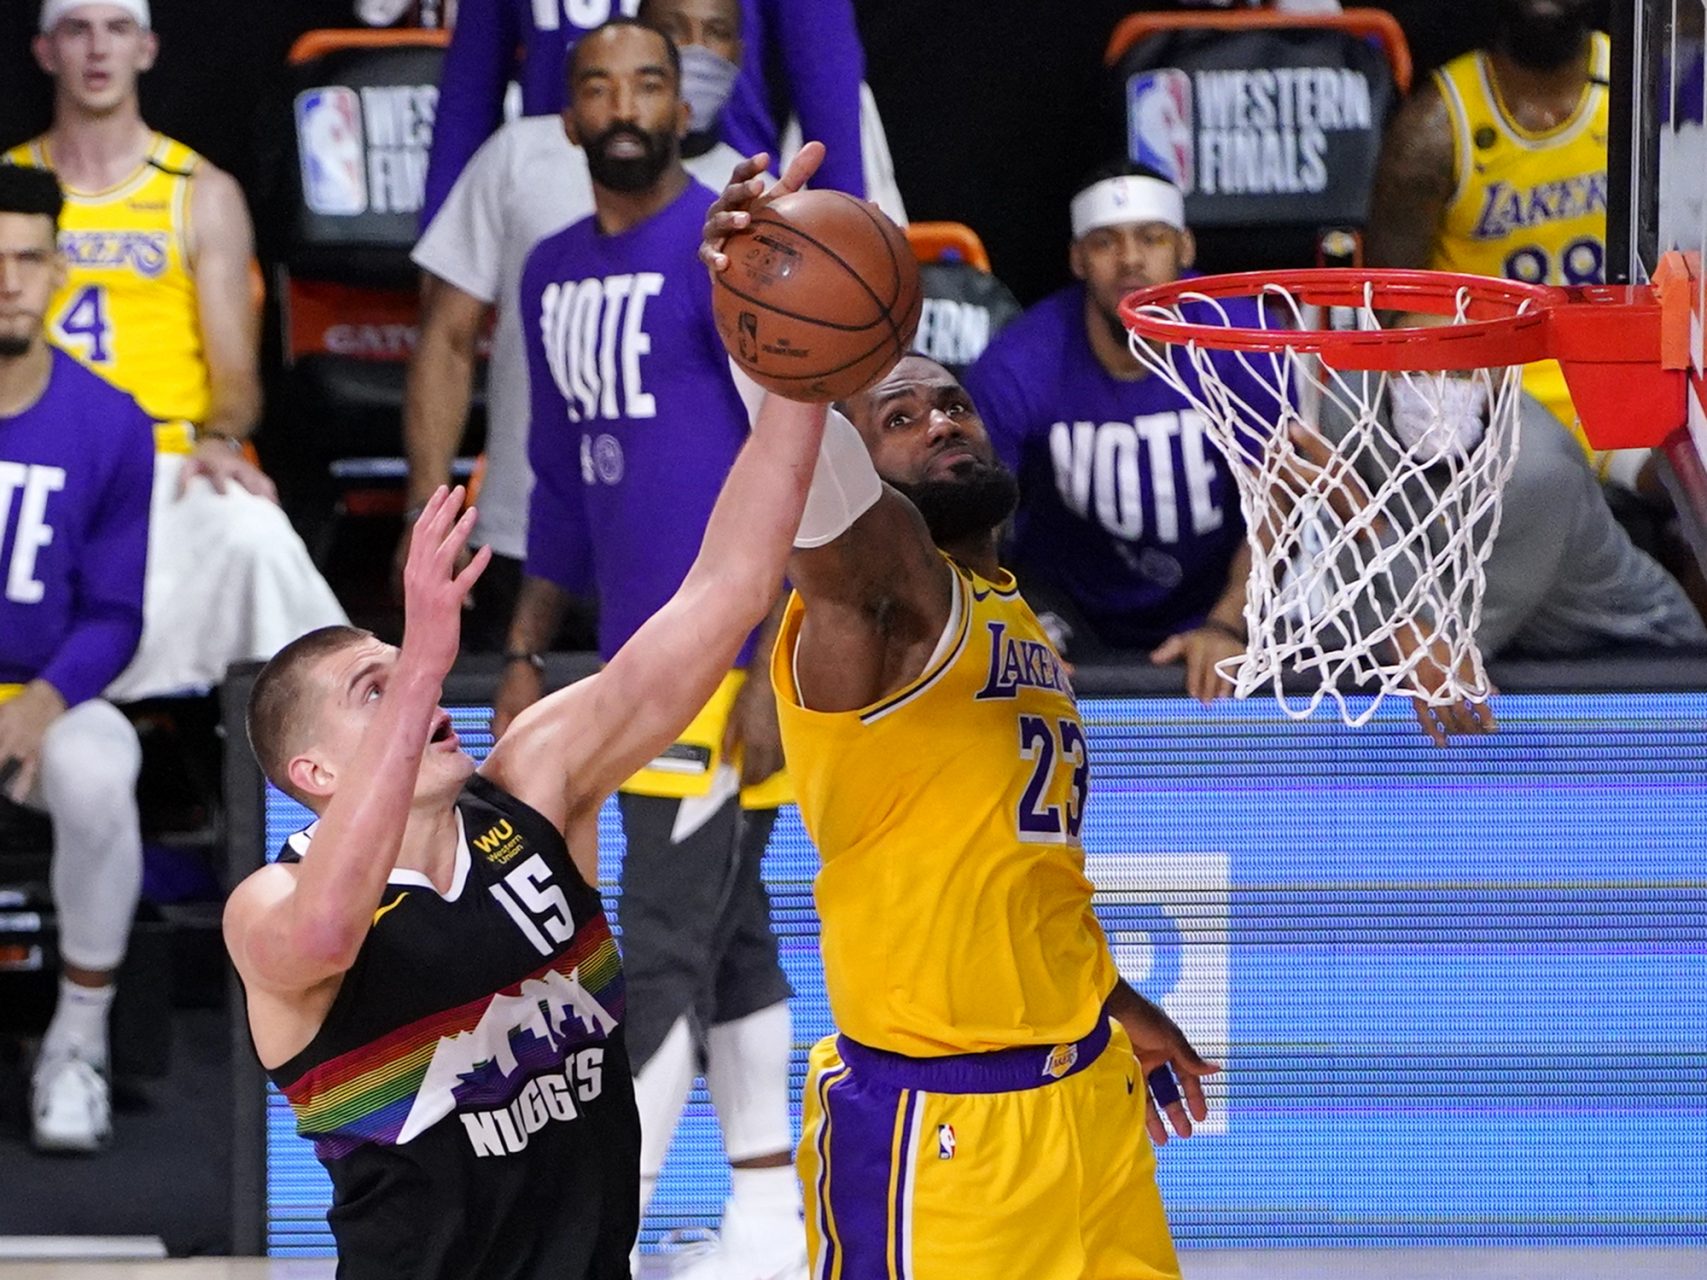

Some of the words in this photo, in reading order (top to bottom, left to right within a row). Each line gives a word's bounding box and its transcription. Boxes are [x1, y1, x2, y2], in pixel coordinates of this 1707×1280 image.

[1196, 66, 1372, 130] WESTERN
[1199, 126, 1328, 195] FINALS
[56, 283, 112, 363] 4
[539, 272, 665, 423] VOTE
[1048, 408, 1225, 544] VOTE
[1017, 712, 1088, 844] 23
[473, 818, 514, 853] WU
[487, 834, 523, 863] Western
[498, 844, 524, 865] Union
[488, 852, 575, 957] 15
